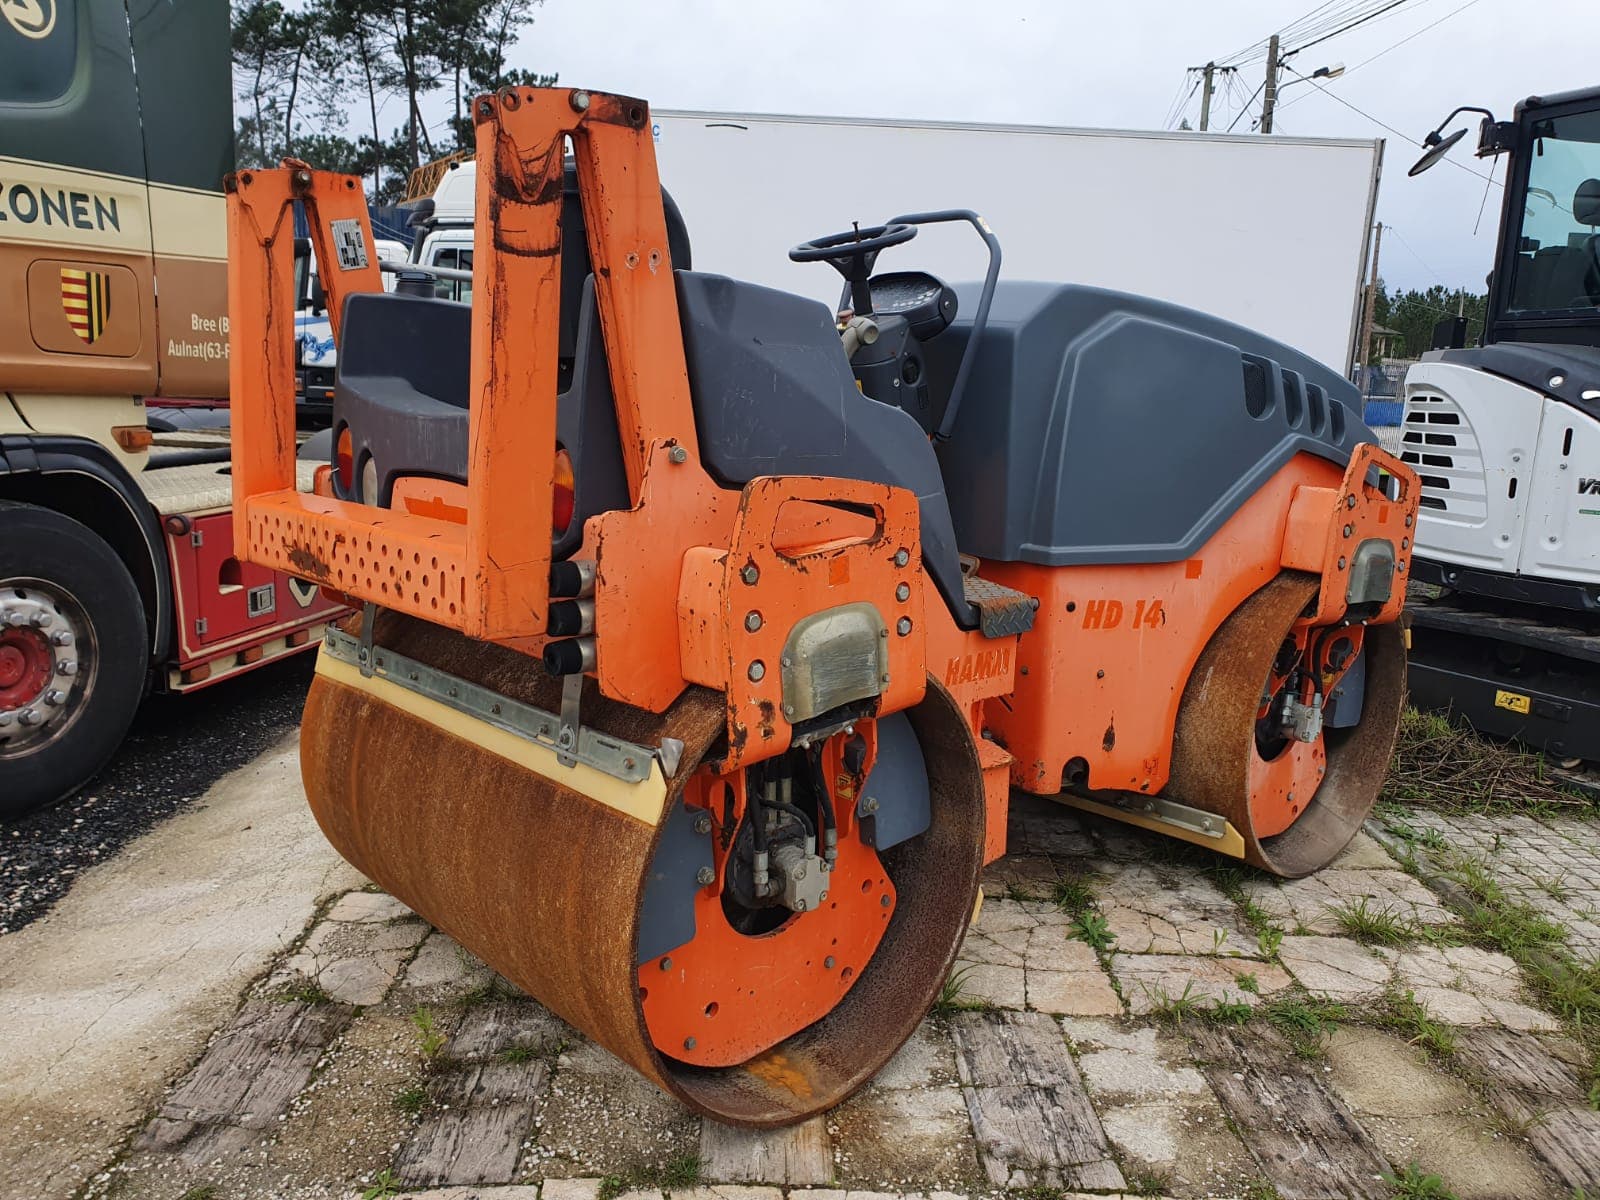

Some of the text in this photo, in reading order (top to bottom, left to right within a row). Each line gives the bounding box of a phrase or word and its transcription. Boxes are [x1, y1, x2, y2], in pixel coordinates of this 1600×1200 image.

[0, 182, 121, 232] ONEN
[191, 313, 217, 331] Bree
[1082, 599, 1163, 630] HD 14
